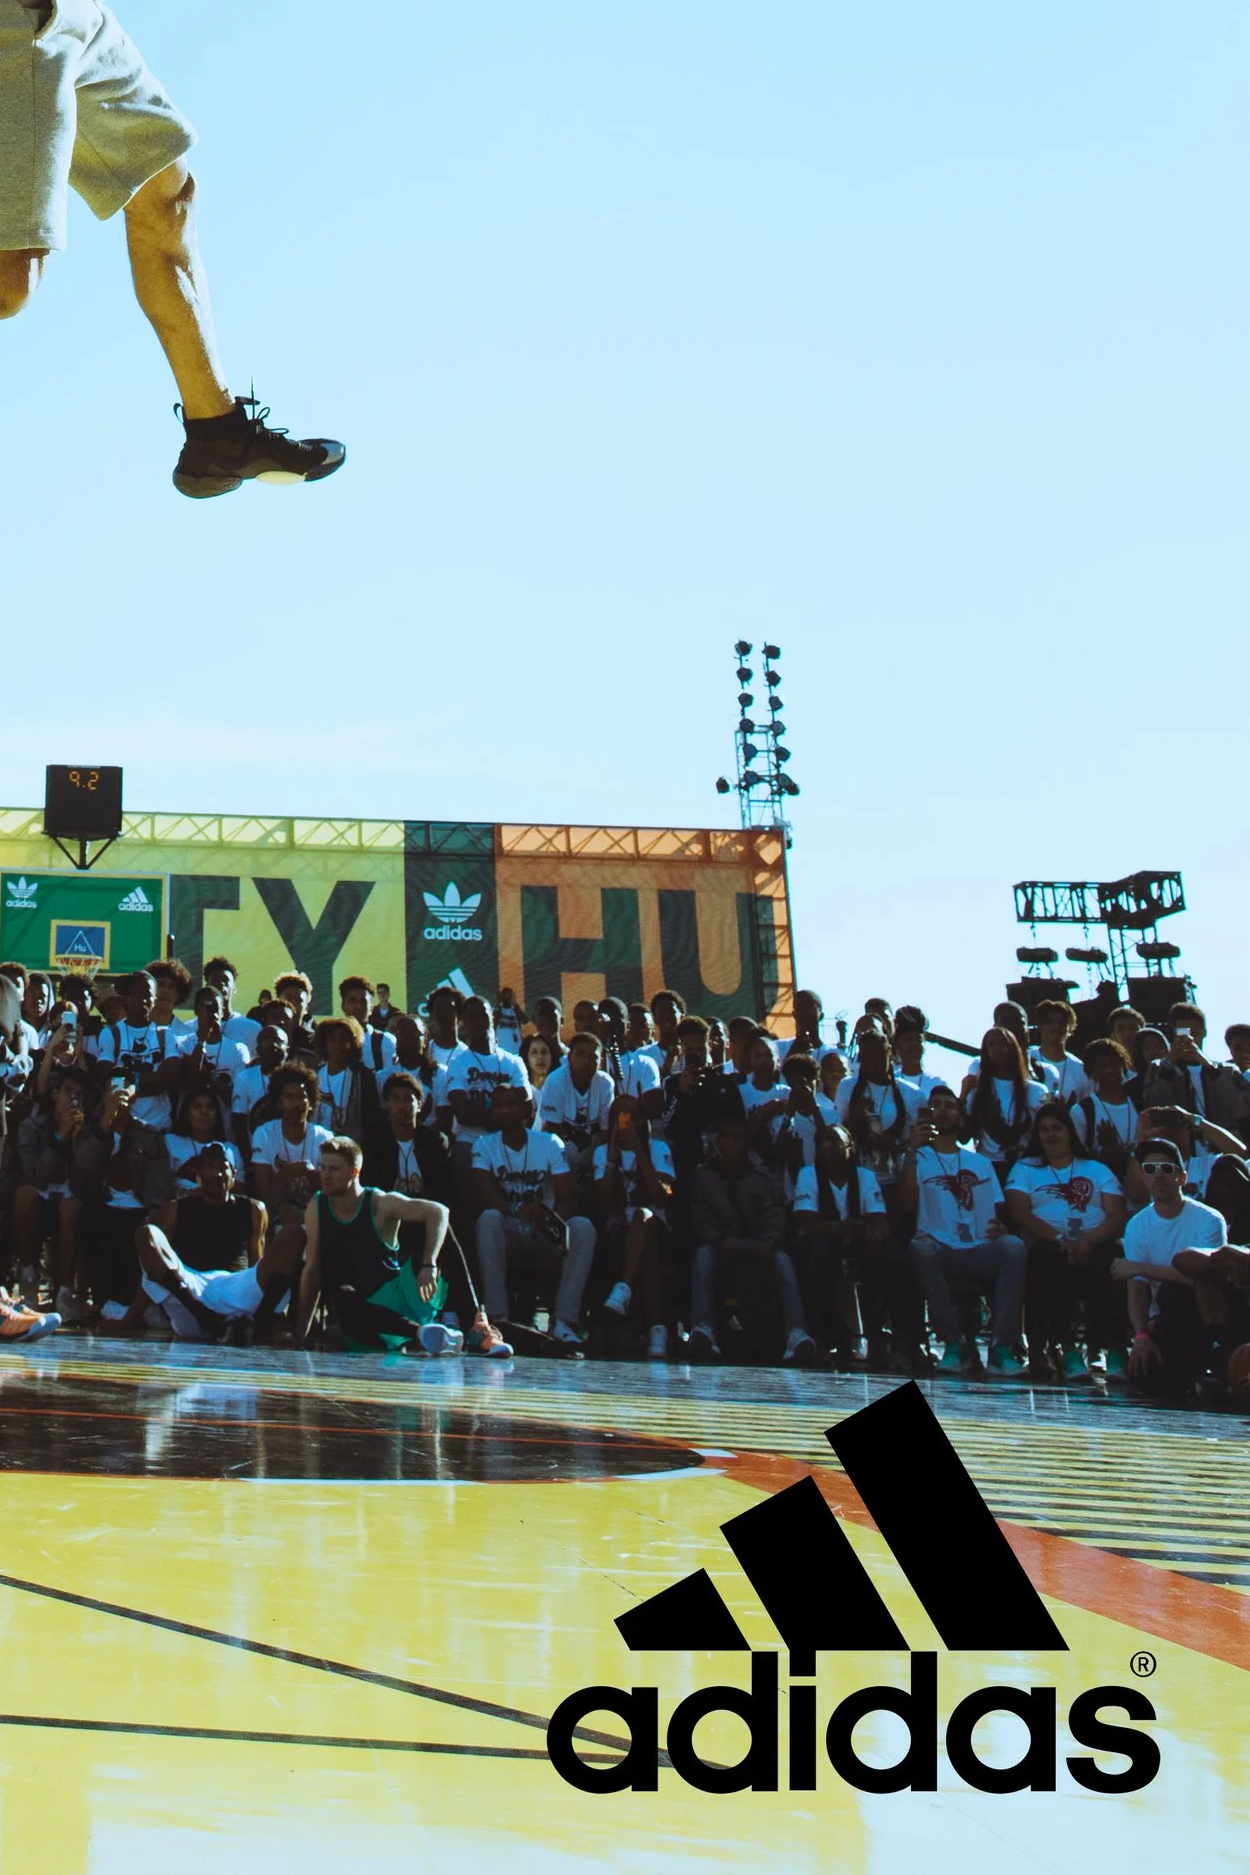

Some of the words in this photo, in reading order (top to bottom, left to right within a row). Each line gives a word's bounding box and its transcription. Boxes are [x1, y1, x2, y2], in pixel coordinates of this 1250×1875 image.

[69, 770, 99, 790] 9.2
[6, 898, 37, 909] adidas
[118, 902, 153, 912] adidas
[423, 925, 483, 941] adidas
[520, 885, 779, 1022] HU
